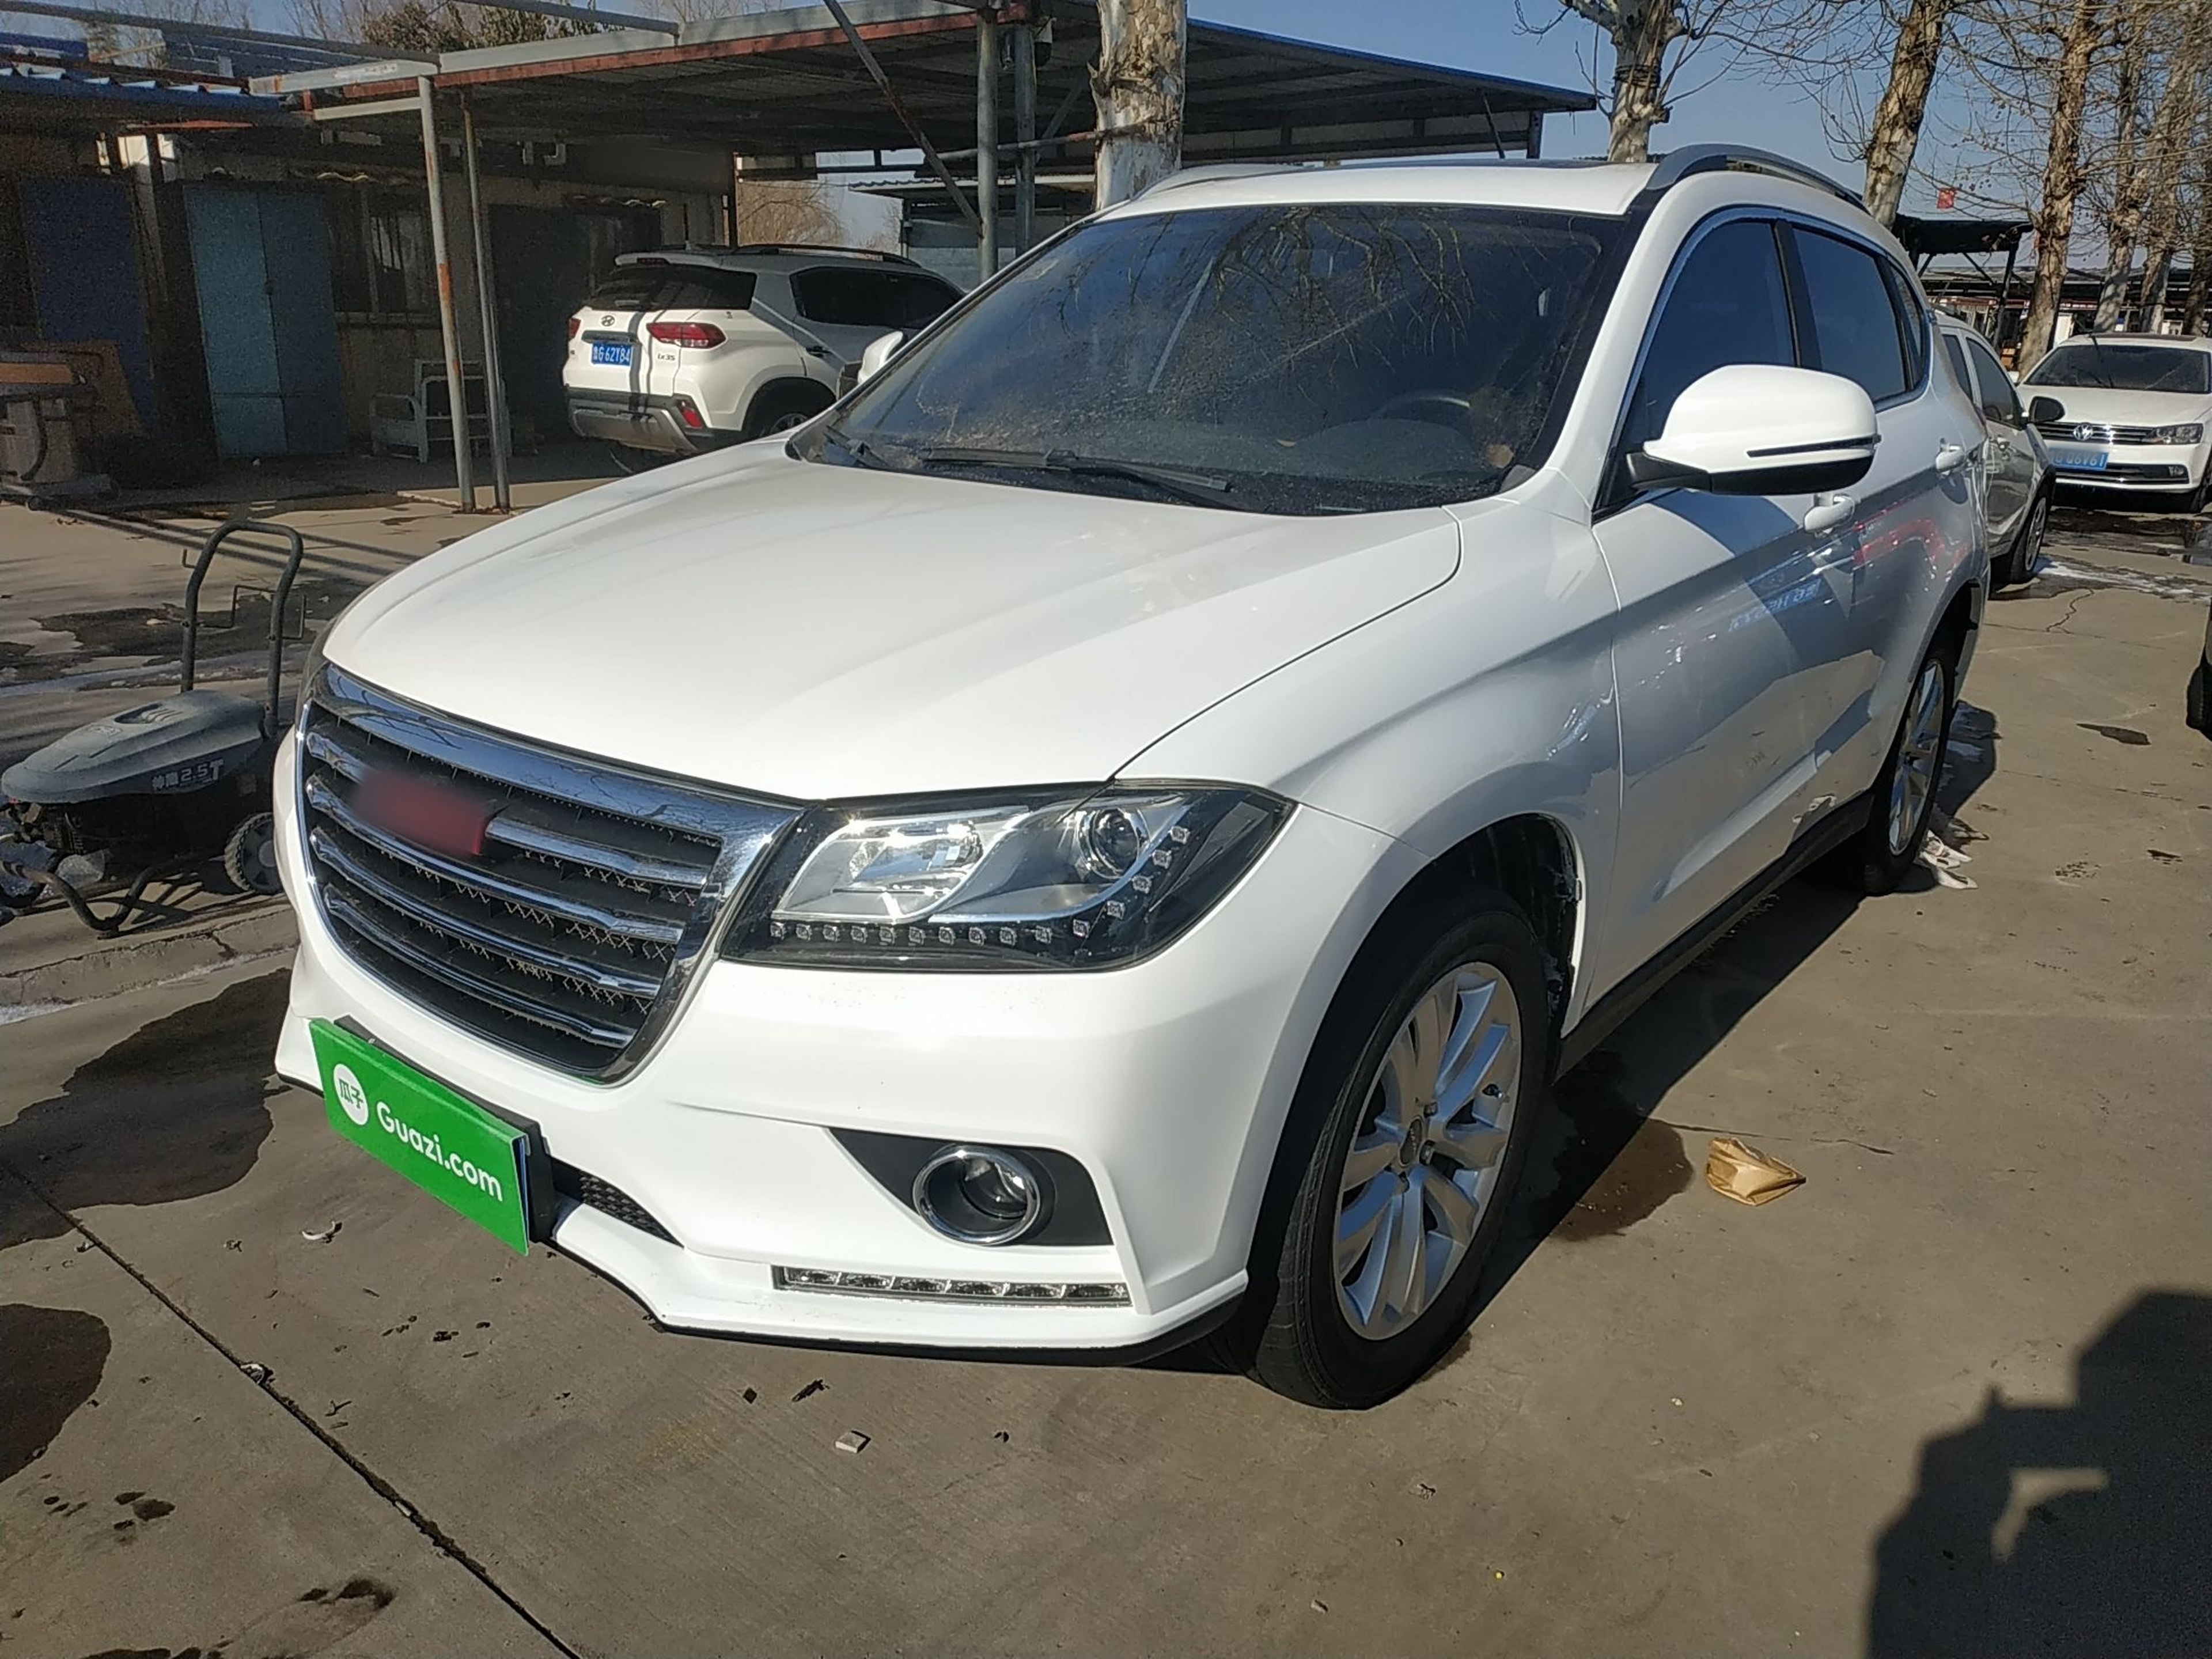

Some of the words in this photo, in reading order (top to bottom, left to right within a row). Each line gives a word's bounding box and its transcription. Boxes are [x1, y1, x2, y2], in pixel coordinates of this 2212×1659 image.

[180, 759, 224, 782] 2.5T
[339, 1078, 363, 1109] 瓜子
[377, 1101, 503, 1202] Guazi.com
